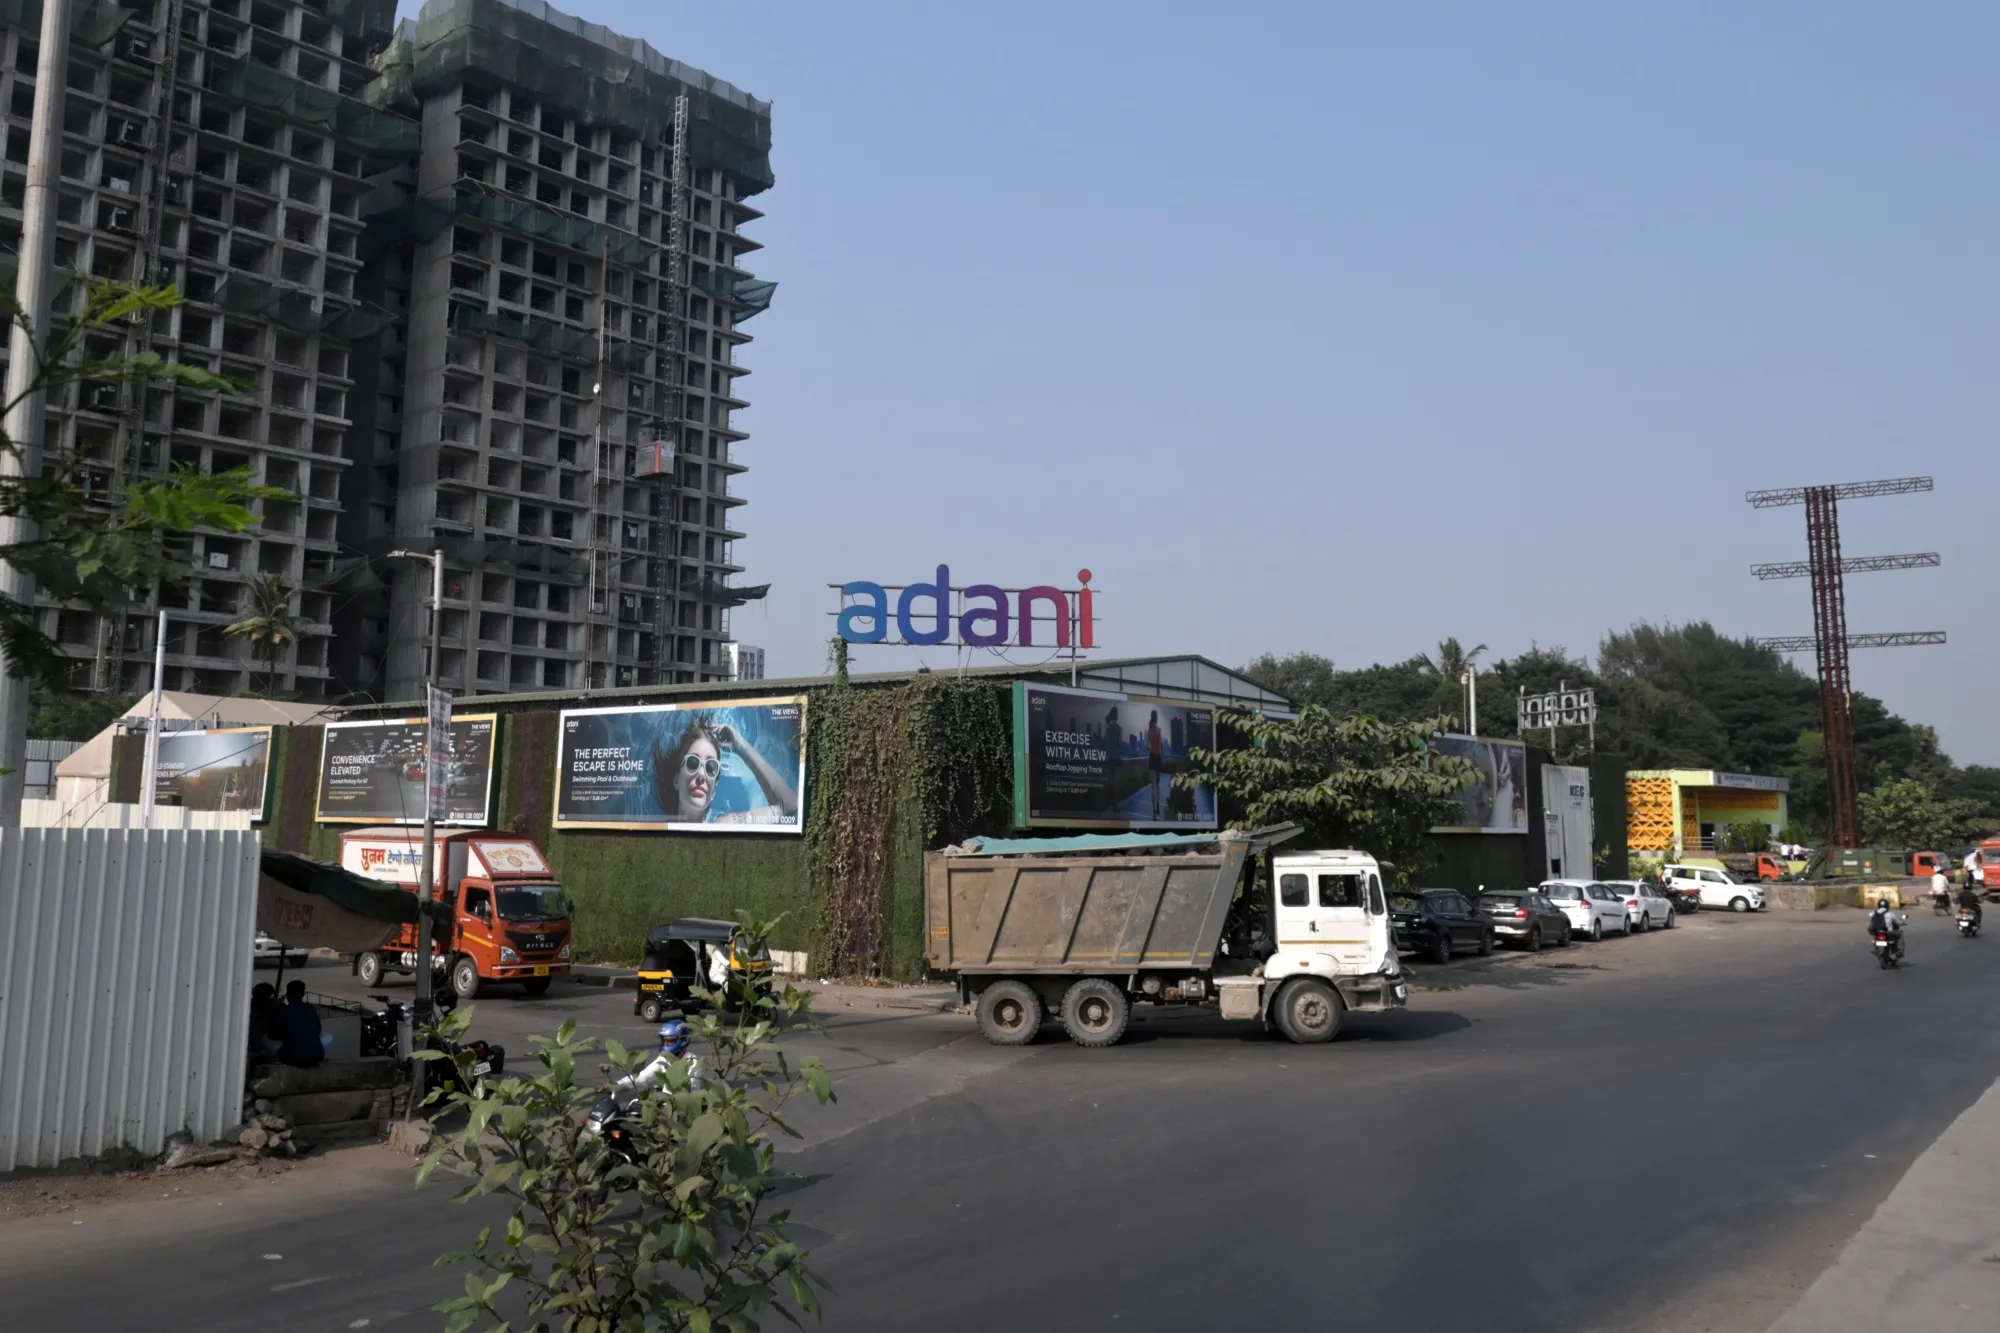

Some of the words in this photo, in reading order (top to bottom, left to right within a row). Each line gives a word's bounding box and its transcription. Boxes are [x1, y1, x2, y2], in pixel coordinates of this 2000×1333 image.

[837, 564, 1093, 648] adani
[1031, 696, 1046, 705] adani
[566, 720, 580, 728] adani
[1045, 731, 1091, 746] EXERCISE
[574, 748, 591, 759] THE
[592, 747, 631, 759] PERFECT
[1045, 745, 1071, 759] WITH
[1073, 748, 1081, 759] A
[1082, 748, 1107, 762] VIEW
[331, 754, 376, 765] CONVENIENCE
[330, 766, 362, 776] ELEVATED
[573, 761, 606, 772] ESCAPE
[607, 761, 616, 771] IS
[617, 760, 644, 771] HOME
[1045, 763, 1067, 772] Rooftop
[1067, 764, 1088, 774] Jogging
[1088, 765, 1103, 773] Track
[572, 775, 597, 783] Swimming
[780, 815, 796, 824] 0009
